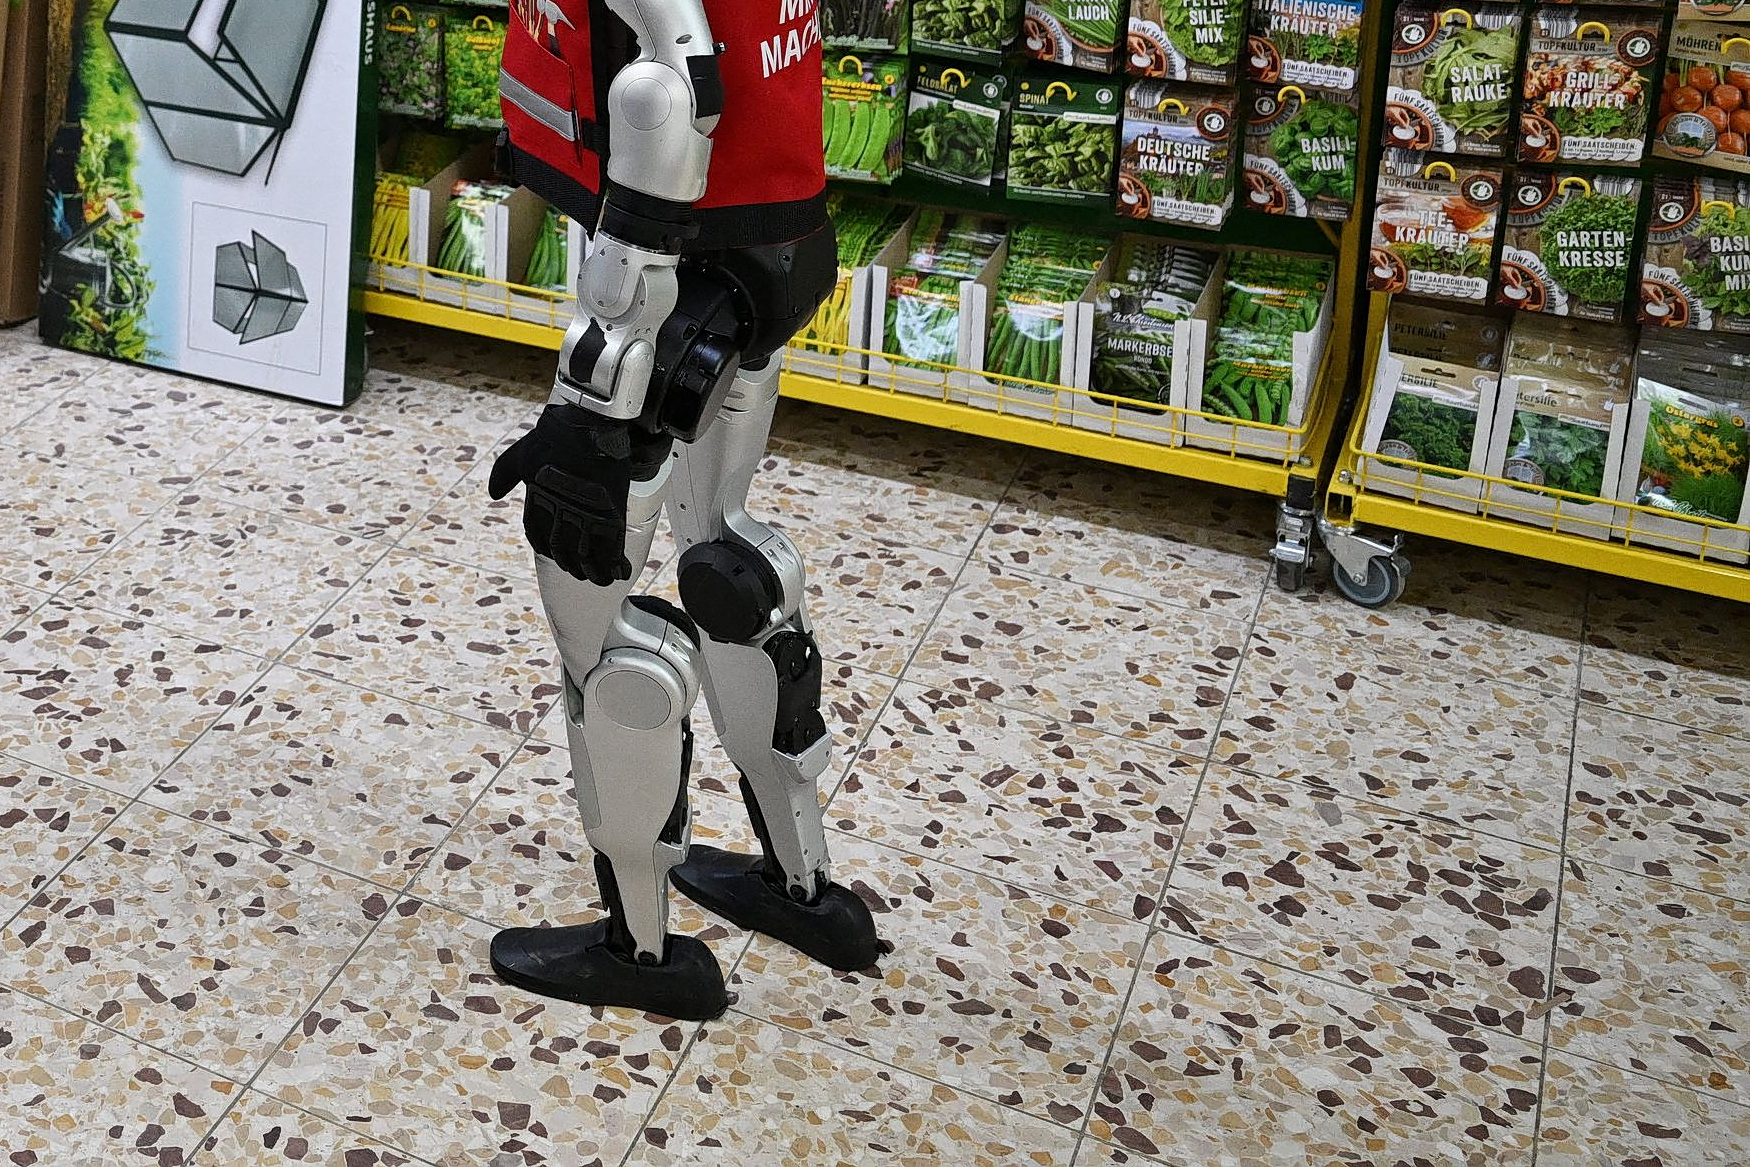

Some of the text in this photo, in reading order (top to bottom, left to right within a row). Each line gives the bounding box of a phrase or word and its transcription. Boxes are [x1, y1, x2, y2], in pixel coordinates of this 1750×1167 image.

[1068, 5, 1110, 21] LAUCH
[1189, 11, 1231, 26] SILIE-
[1195, 27, 1224, 43] MIX
[1270, 13, 1336, 38] KRÄUTER
[1537, 40, 1596, 52] TOPFKULTUR
[1450, 63, 1506, 83] SALAT-
[1566, 70, 1620, 90] GRILL-
[1451, 83, 1507, 103] RAUKE
[1550, 90, 1626, 110] KRÄUTER
[1137, 136, 1210, 160] DEUTSCHE
[1301, 136, 1357, 154] BASILI-
[1139, 154, 1204, 176] KRÄUTER
[1312, 155, 1346, 172] KUM
[1383, 177, 1440, 192] TOPFKULTUR
[1418, 210, 1454, 229] TEE-
[1395, 228, 1470, 248] KRÄUTER
[1556, 230, 1633, 248] GARTEN-
[1559, 249, 1626, 268] KRESSE
[1107, 337, 1174, 358] MARKERBSE
[1401, 373, 1438, 389] ERSILIE
[1516, 392, 1558, 408] tersilie
[1665, 404, 1719, 429] Ostergras
